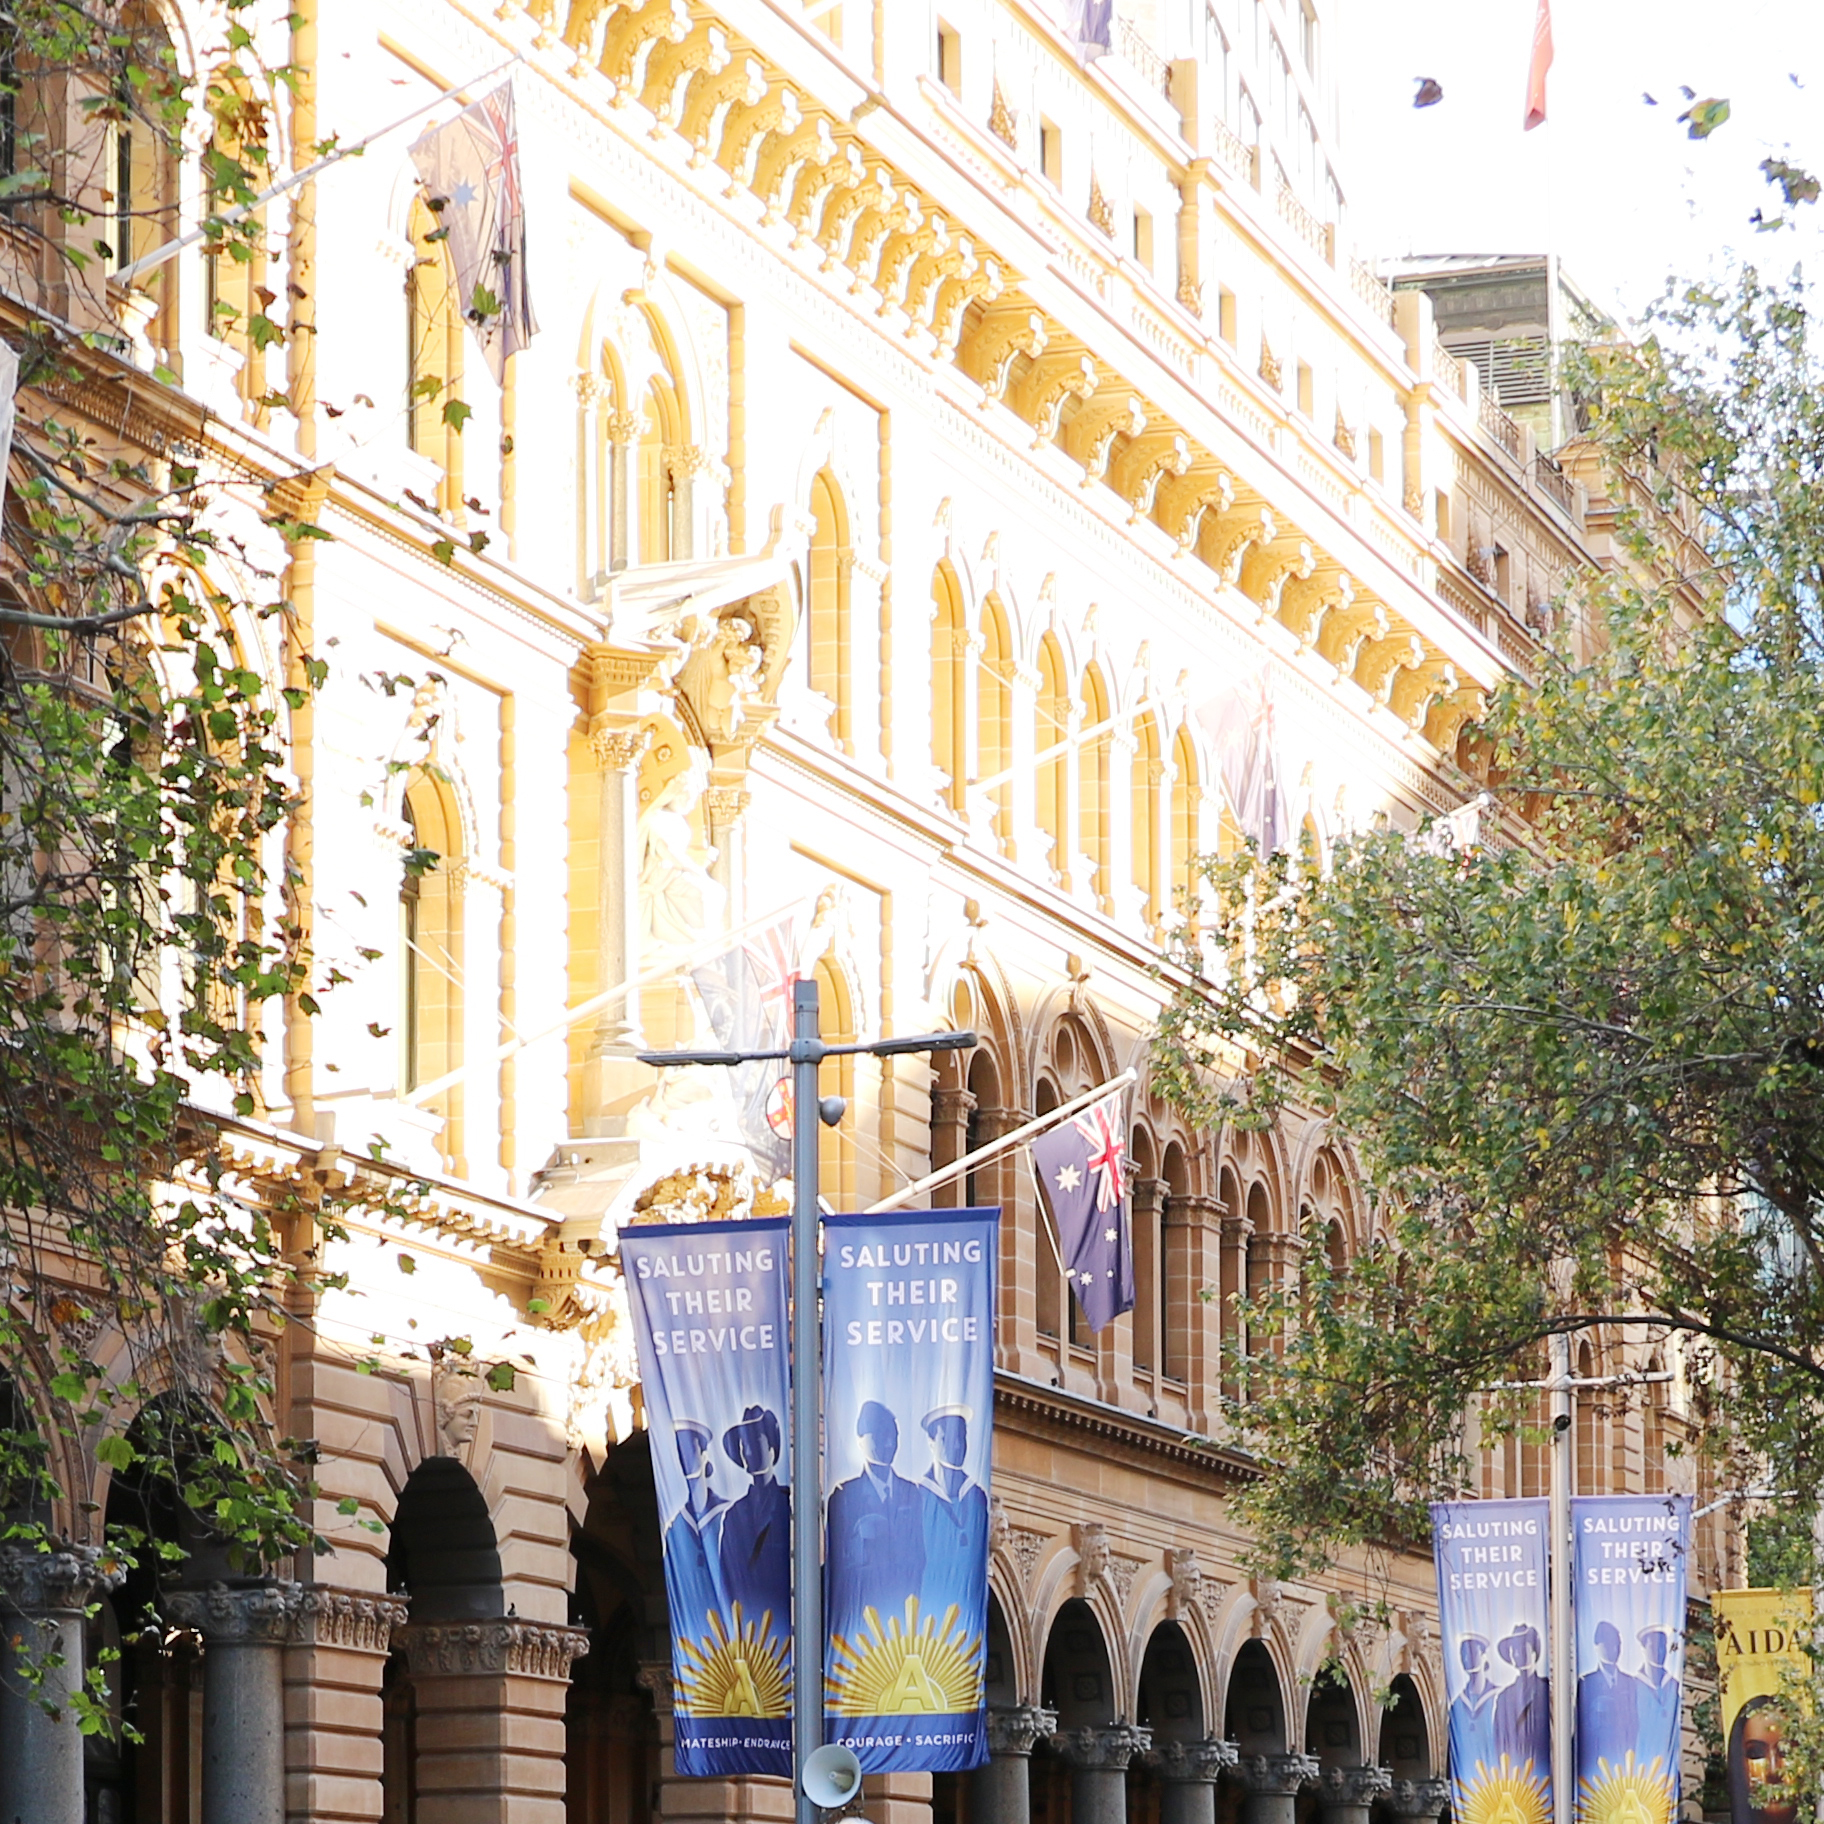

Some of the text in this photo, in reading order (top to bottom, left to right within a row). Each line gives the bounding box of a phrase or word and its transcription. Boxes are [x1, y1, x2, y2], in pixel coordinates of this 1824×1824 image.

[637, 1248, 774, 1280] SALUTING
[840, 1240, 982, 1269] SALUTING
[664, 1287, 753, 1316] THEIR
[866, 1279, 958, 1307] THEIR
[653, 1324, 775, 1356] SERVICE
[847, 1316, 978, 1346] SERVICE
[1441, 1519, 1538, 1539] SALUTING
[1583, 1515, 1681, 1534] SALUTING
[1460, 1546, 1523, 1564] THEIR
[1601, 1541, 1664, 1559] THEIR
[1449, 1569, 1538, 1590] SERVICE
[1587, 1566, 1677, 1586] SERVICE
[681, 1736, 739, 1749] MATESHIP
[837, 1733, 976, 1748] COURAGE SACRIFIC
